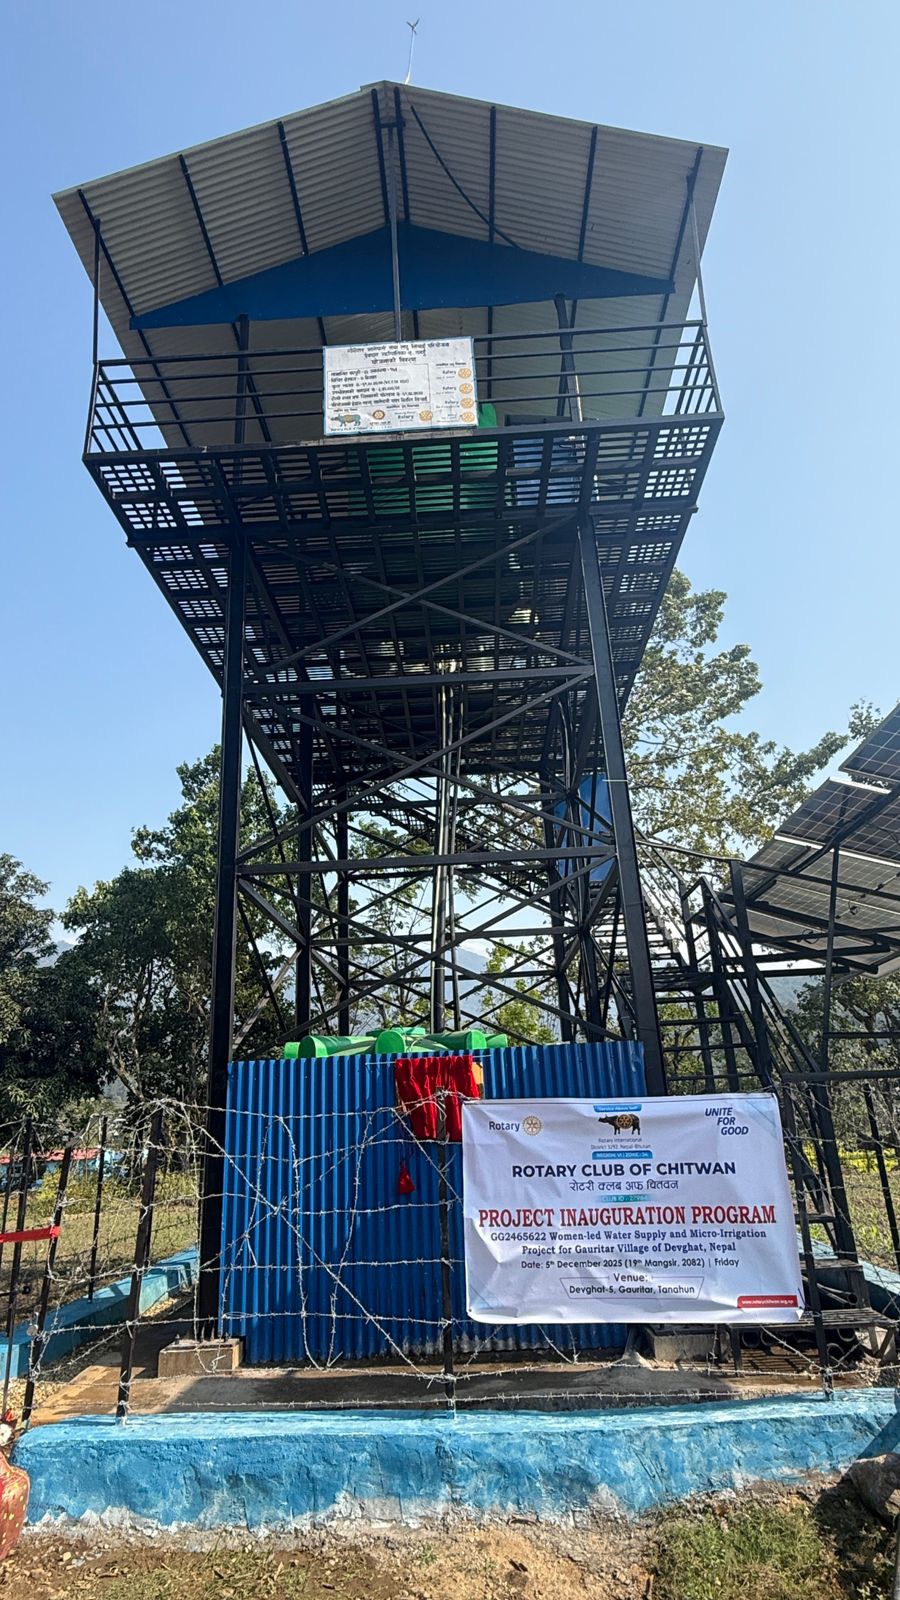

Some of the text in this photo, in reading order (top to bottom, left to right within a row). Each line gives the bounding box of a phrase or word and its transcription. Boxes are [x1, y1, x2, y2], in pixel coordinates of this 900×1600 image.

[705, 1107, 733, 1116] UNITE
[488, 1121, 520, 1132] Rotary
[717, 1116, 736, 1126] FOR
[720, 1126, 749, 1136] GOOD
[512, 1162, 736, 1178] ROTARY CLUB OF CHITWAN
[569, 1178, 678, 1191] रोटरी क्लब अफ चितवन
[478, 1205, 776, 1228] PROJECT INAUGURATION PROGRAM
[490, 1229, 767, 1242] GG2465622 Women-led Water Supply and Micro-Irrigation
[522, 1242, 736, 1256] Project for Gauritar Village of Devghat, Nepal
[522, 1261, 544, 1269] Date:
[557, 1260, 601, 1268] December
[603, 1260, 622, 1268] 2025
[644, 1259, 680, 1269] Mangsir,
[682, 1258, 705, 1268] 2082)
[714, 1258, 740, 1268] Friday
[613, 1273, 648, 1282] Venue:
[570, 1285, 694, 1295] Devghat-5, Gauritar, Tanahun
